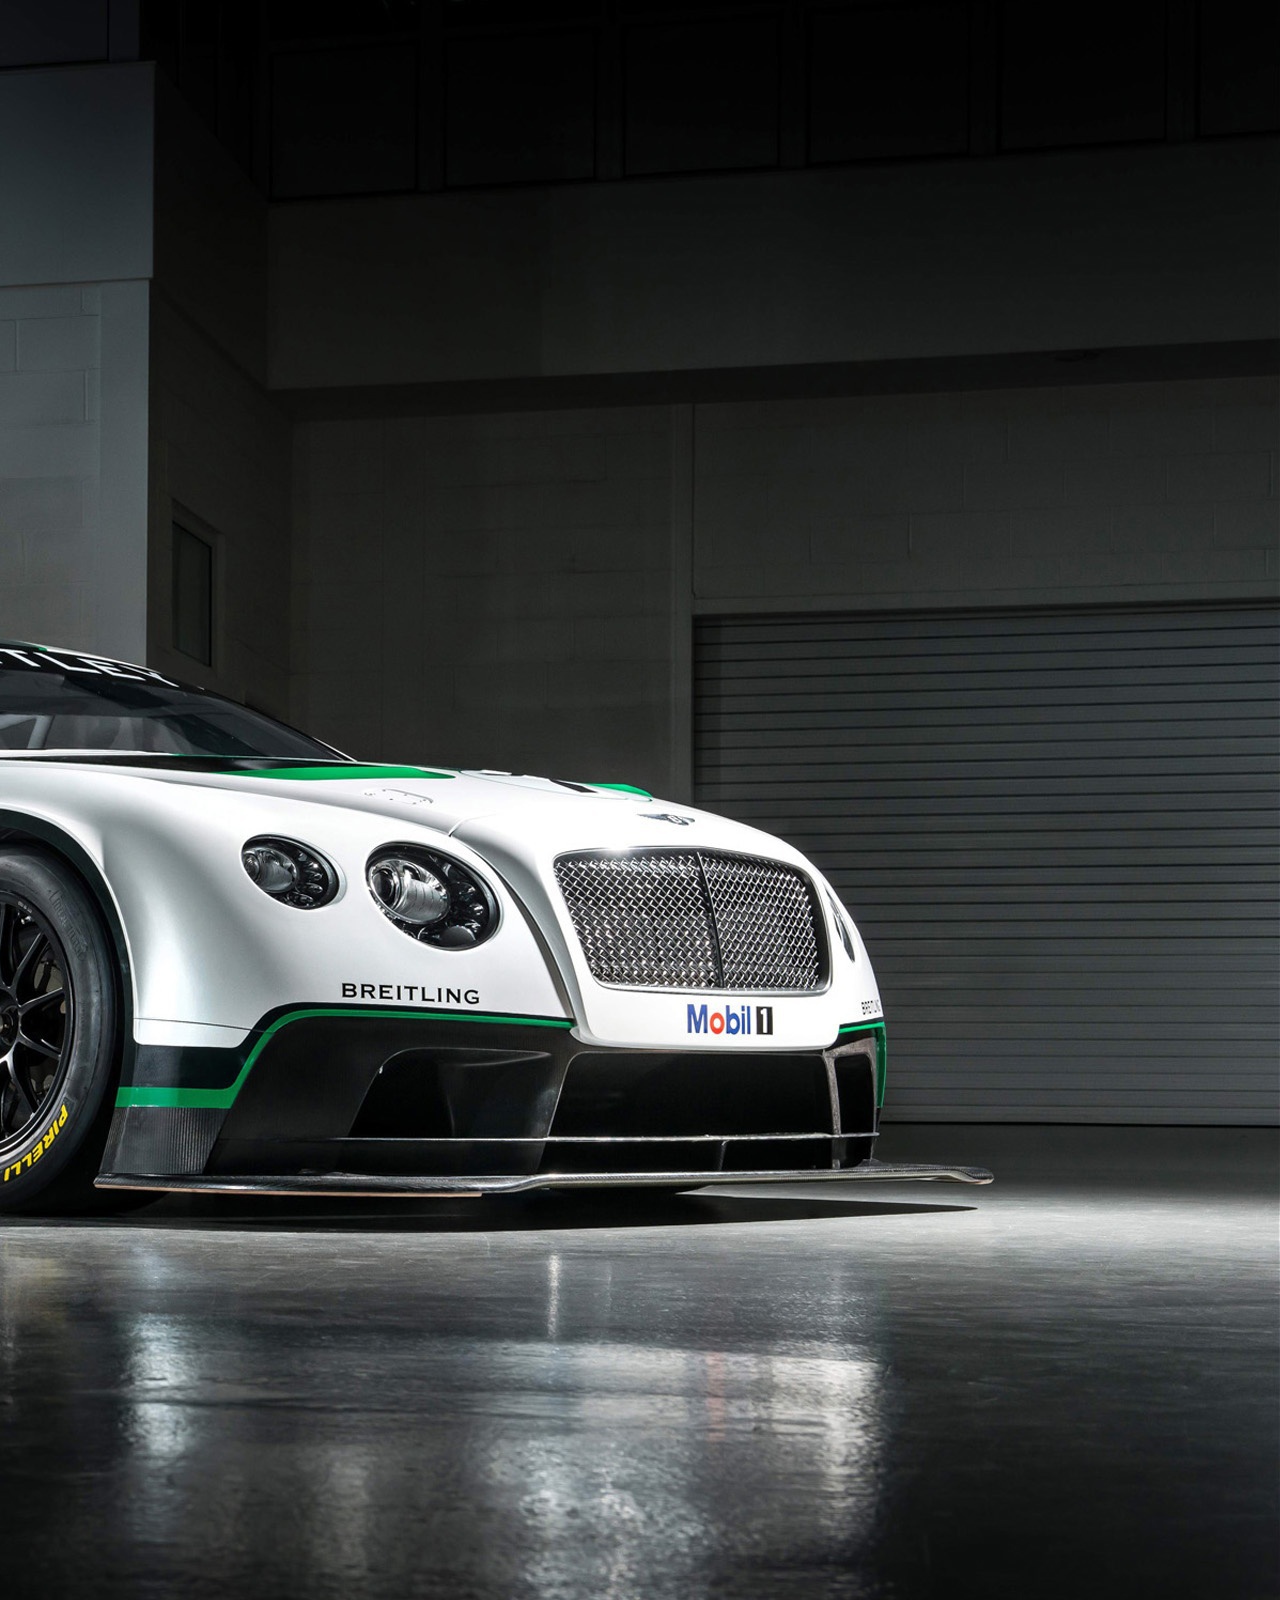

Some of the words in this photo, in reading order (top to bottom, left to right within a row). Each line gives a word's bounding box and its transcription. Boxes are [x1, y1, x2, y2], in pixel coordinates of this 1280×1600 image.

[341, 982, 480, 1005] BREITLING
[687, 1003, 751, 1035] Mobil
[4, 1104, 69, 1182] PIRELLI
